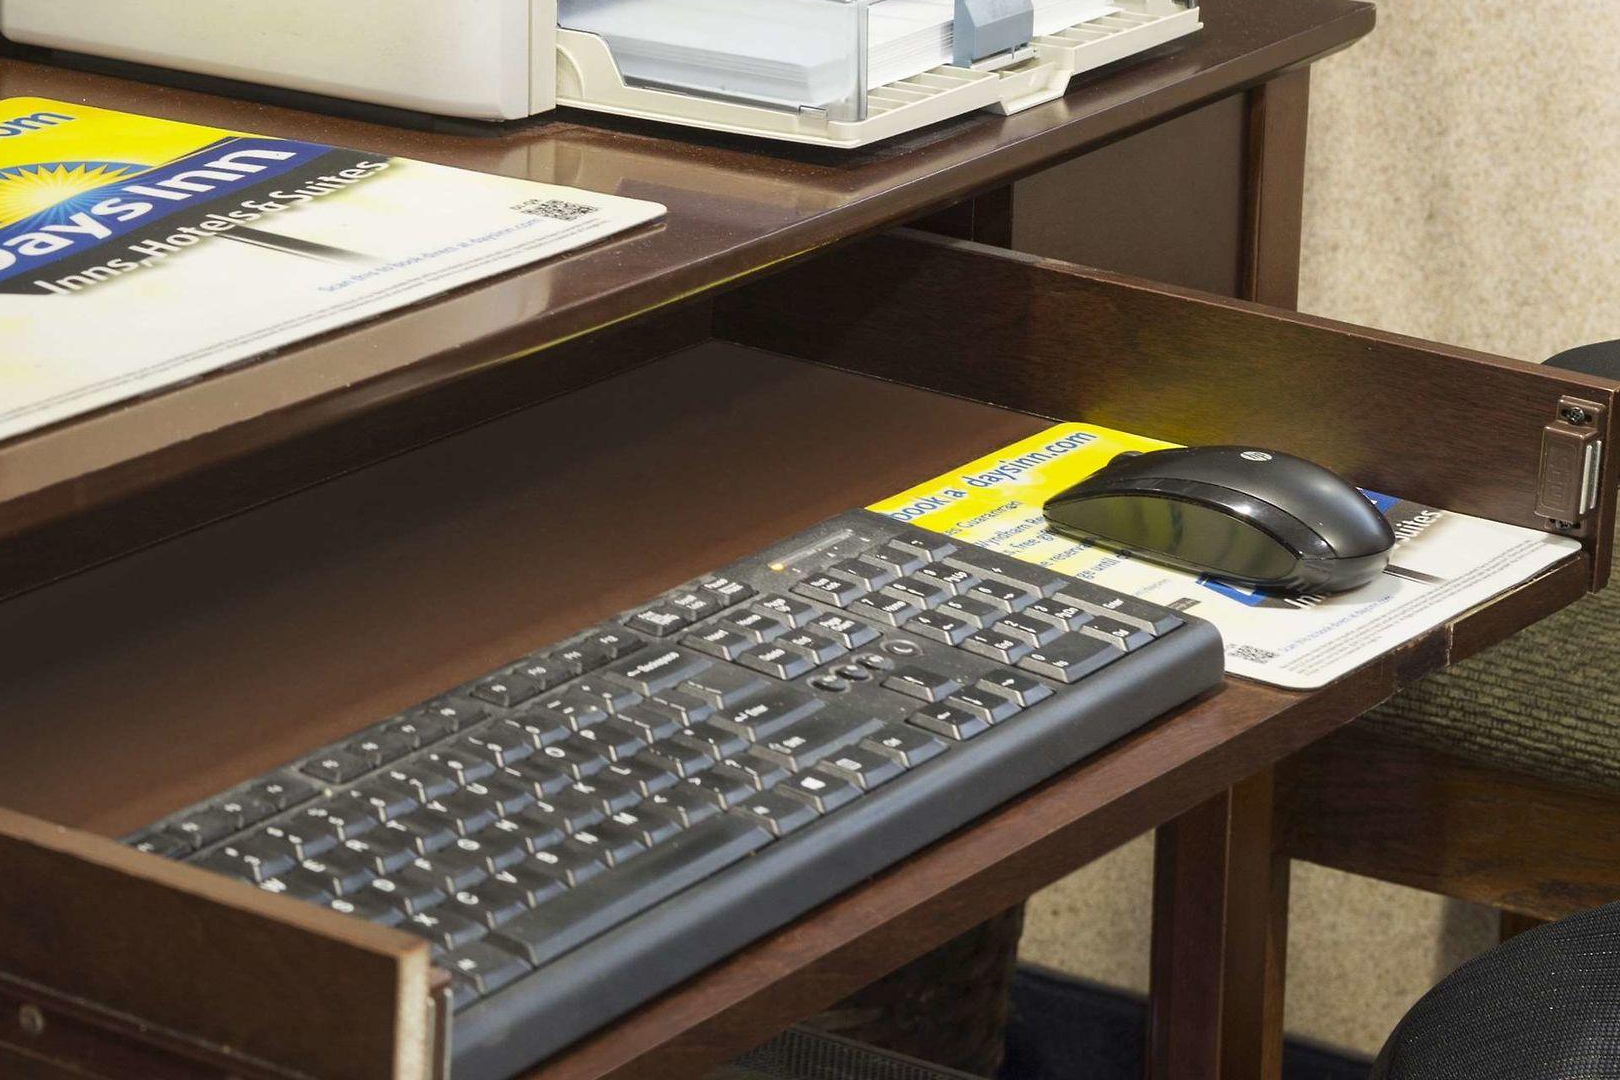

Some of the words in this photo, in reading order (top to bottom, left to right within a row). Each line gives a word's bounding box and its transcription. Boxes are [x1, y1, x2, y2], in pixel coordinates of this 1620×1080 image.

[122, 149, 296, 201] Inn
[34, 255, 152, 297] Inns,
[128, 209, 262, 259] Hotels
[242, 199, 282, 214] &
[269, 159, 391, 204] Suites
[962, 431, 1098, 488] daysinn.com
